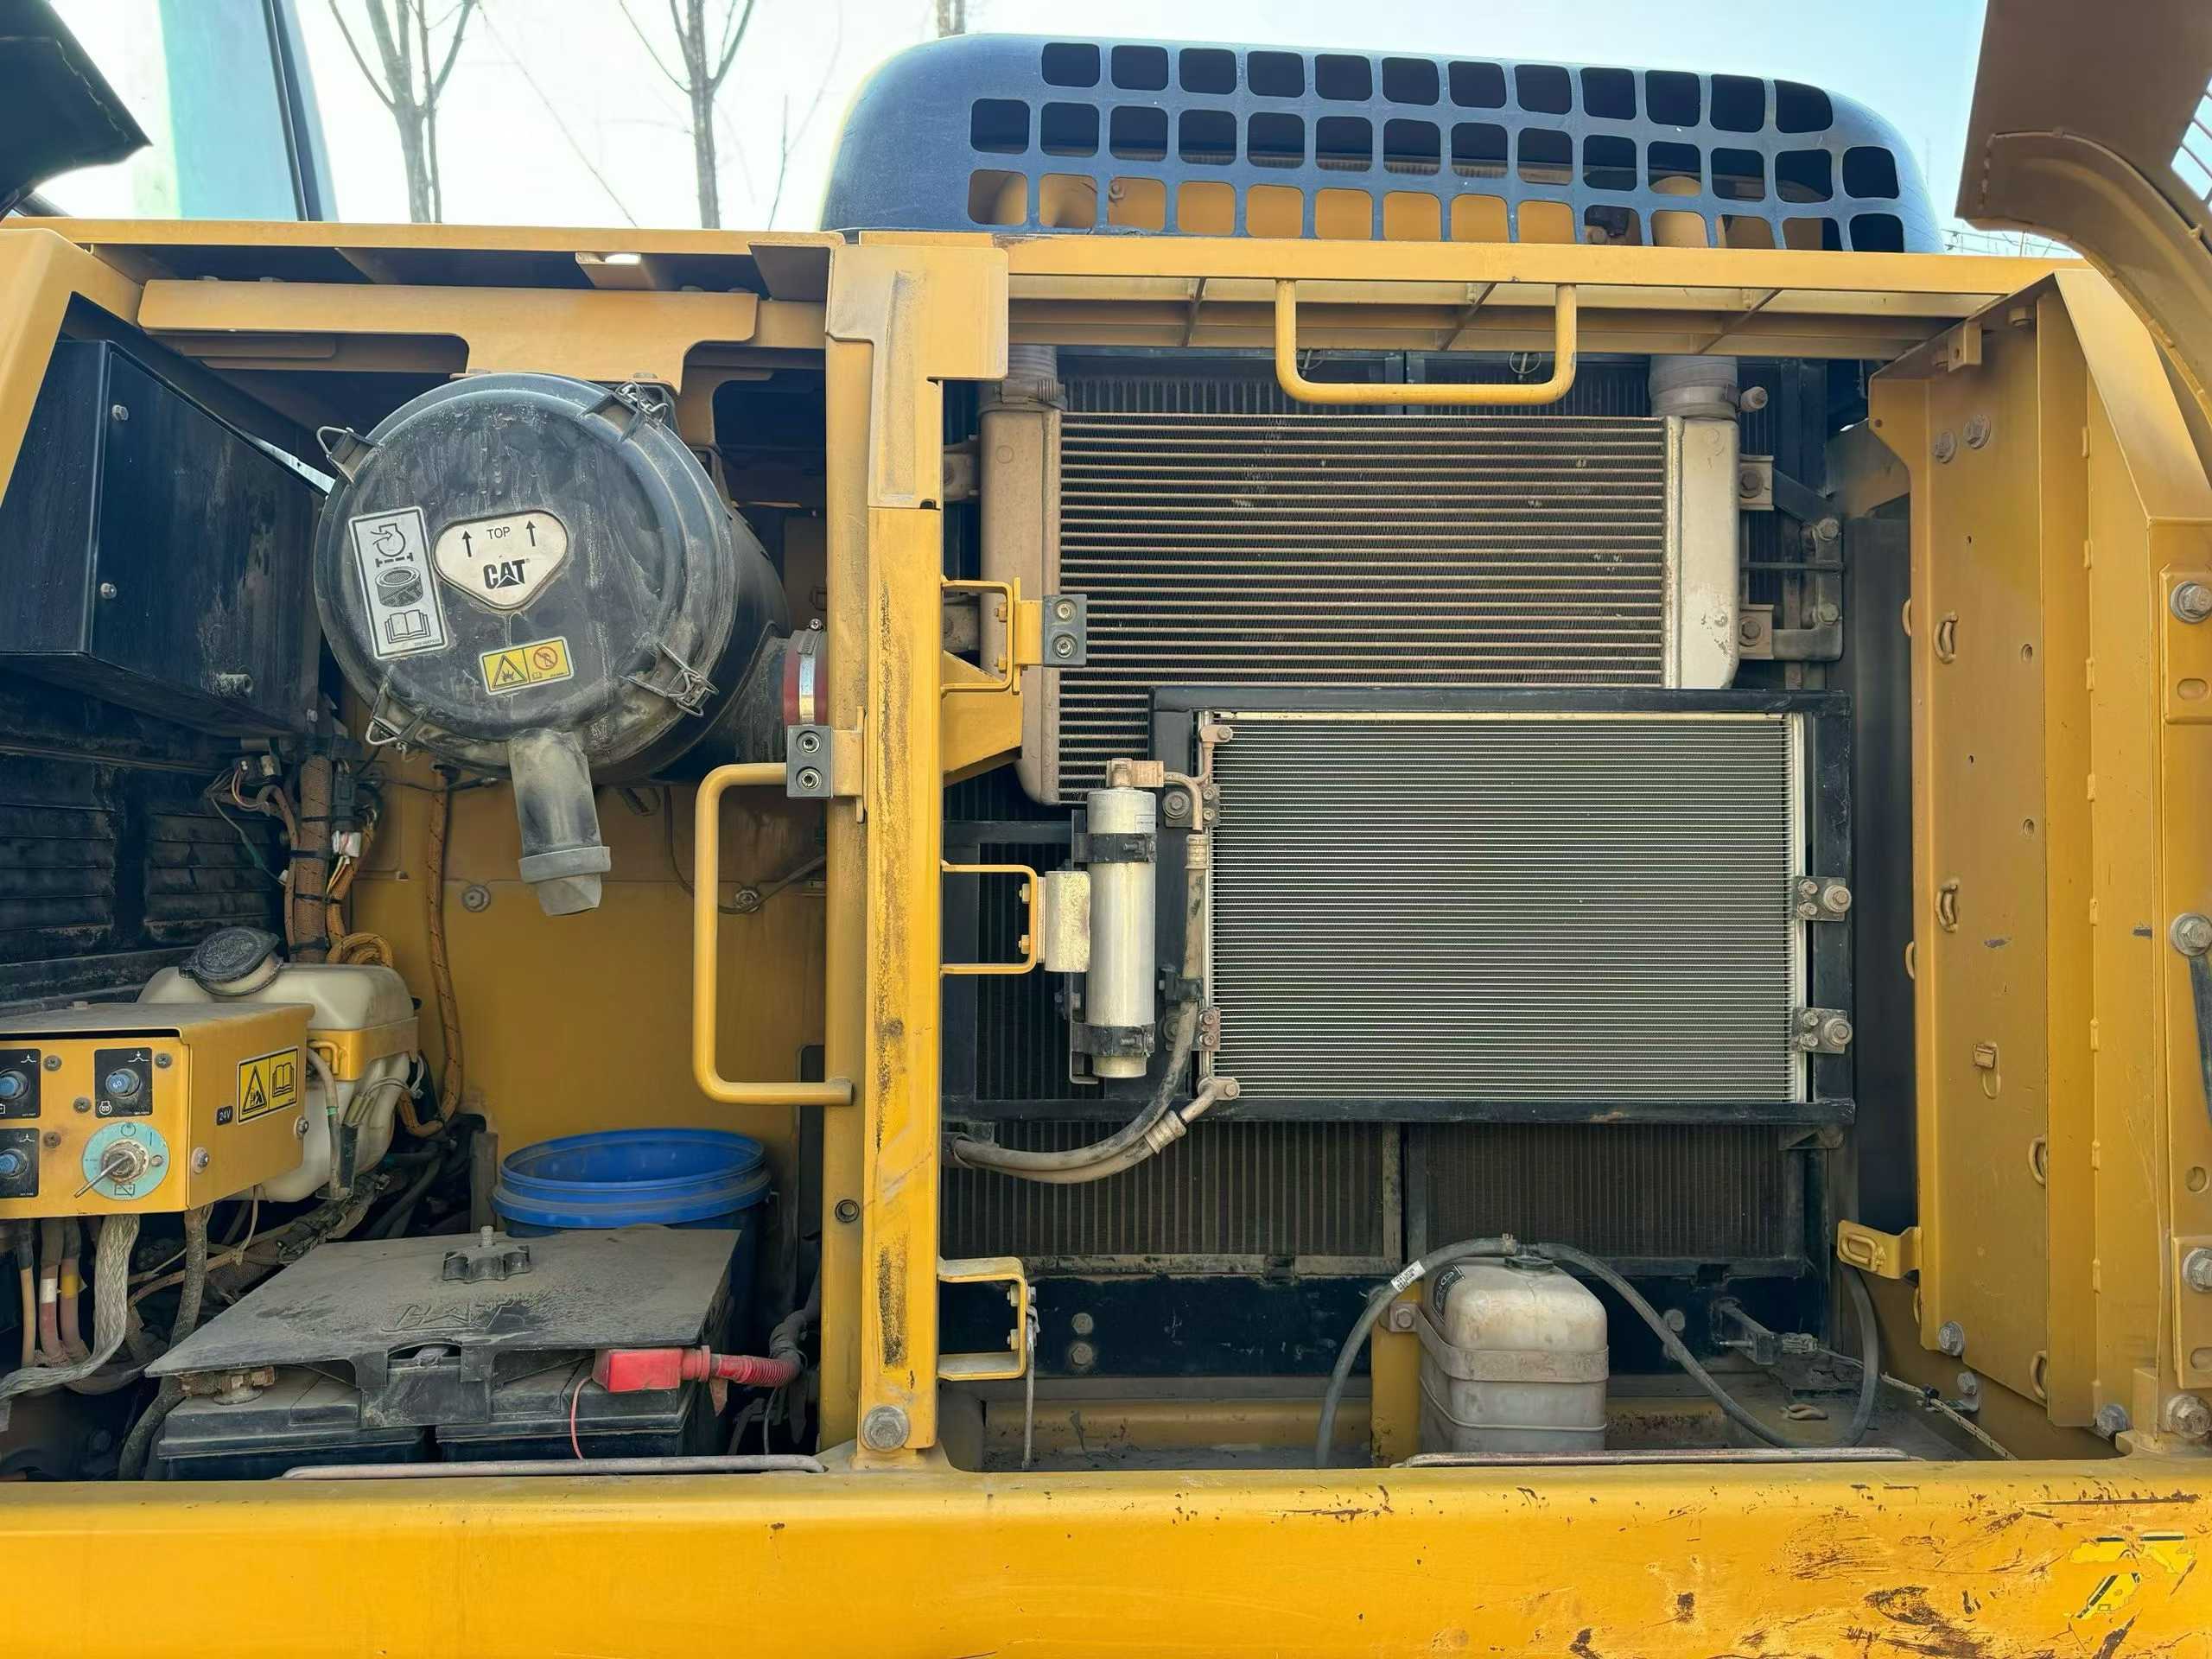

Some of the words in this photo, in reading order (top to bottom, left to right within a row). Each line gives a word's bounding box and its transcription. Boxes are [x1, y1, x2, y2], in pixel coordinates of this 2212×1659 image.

[486, 526, 511, 539] TOP
[483, 559, 525, 589] CAT
[219, 1108, 231, 1121] 24V
